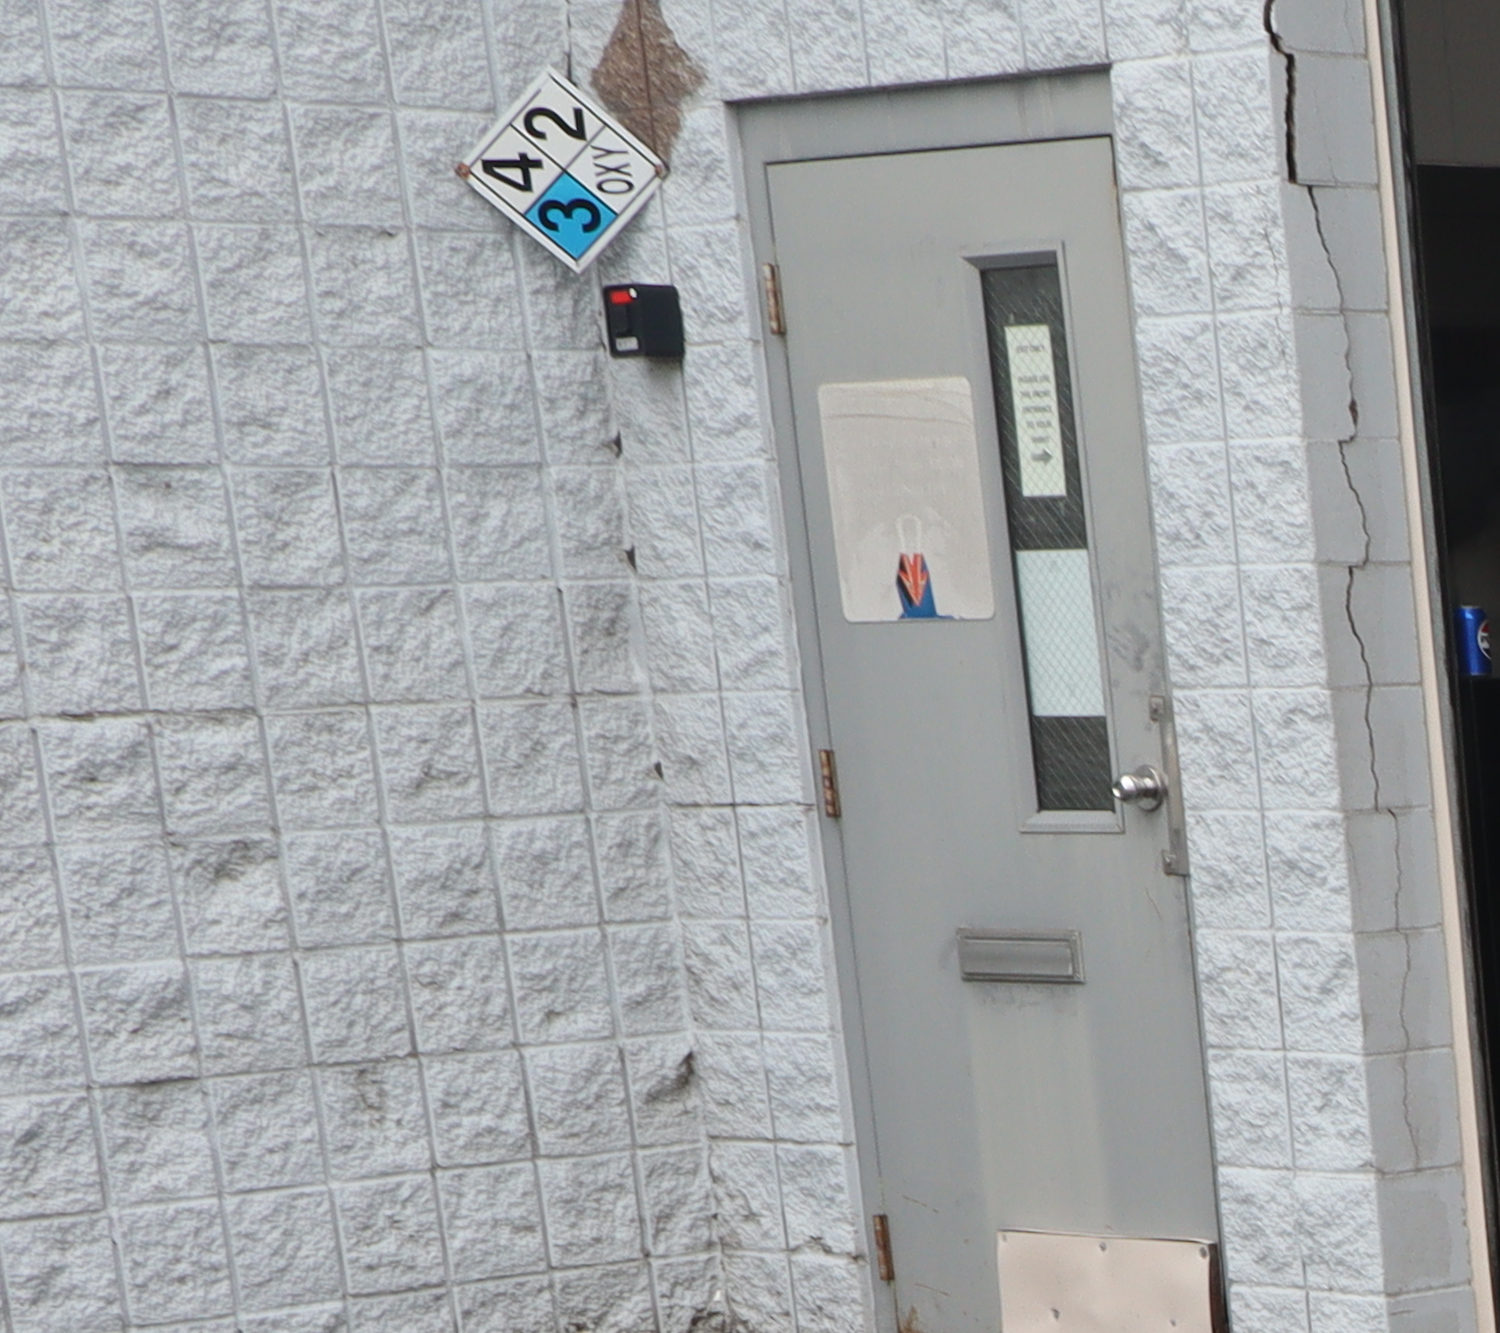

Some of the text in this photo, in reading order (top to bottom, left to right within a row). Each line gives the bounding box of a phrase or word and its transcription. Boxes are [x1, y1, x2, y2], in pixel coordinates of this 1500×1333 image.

[523, 104, 588, 144] 2
[481, 152, 544, 194] 4
[592, 144, 636, 196] OXY
[537, 196, 602, 236] 3
